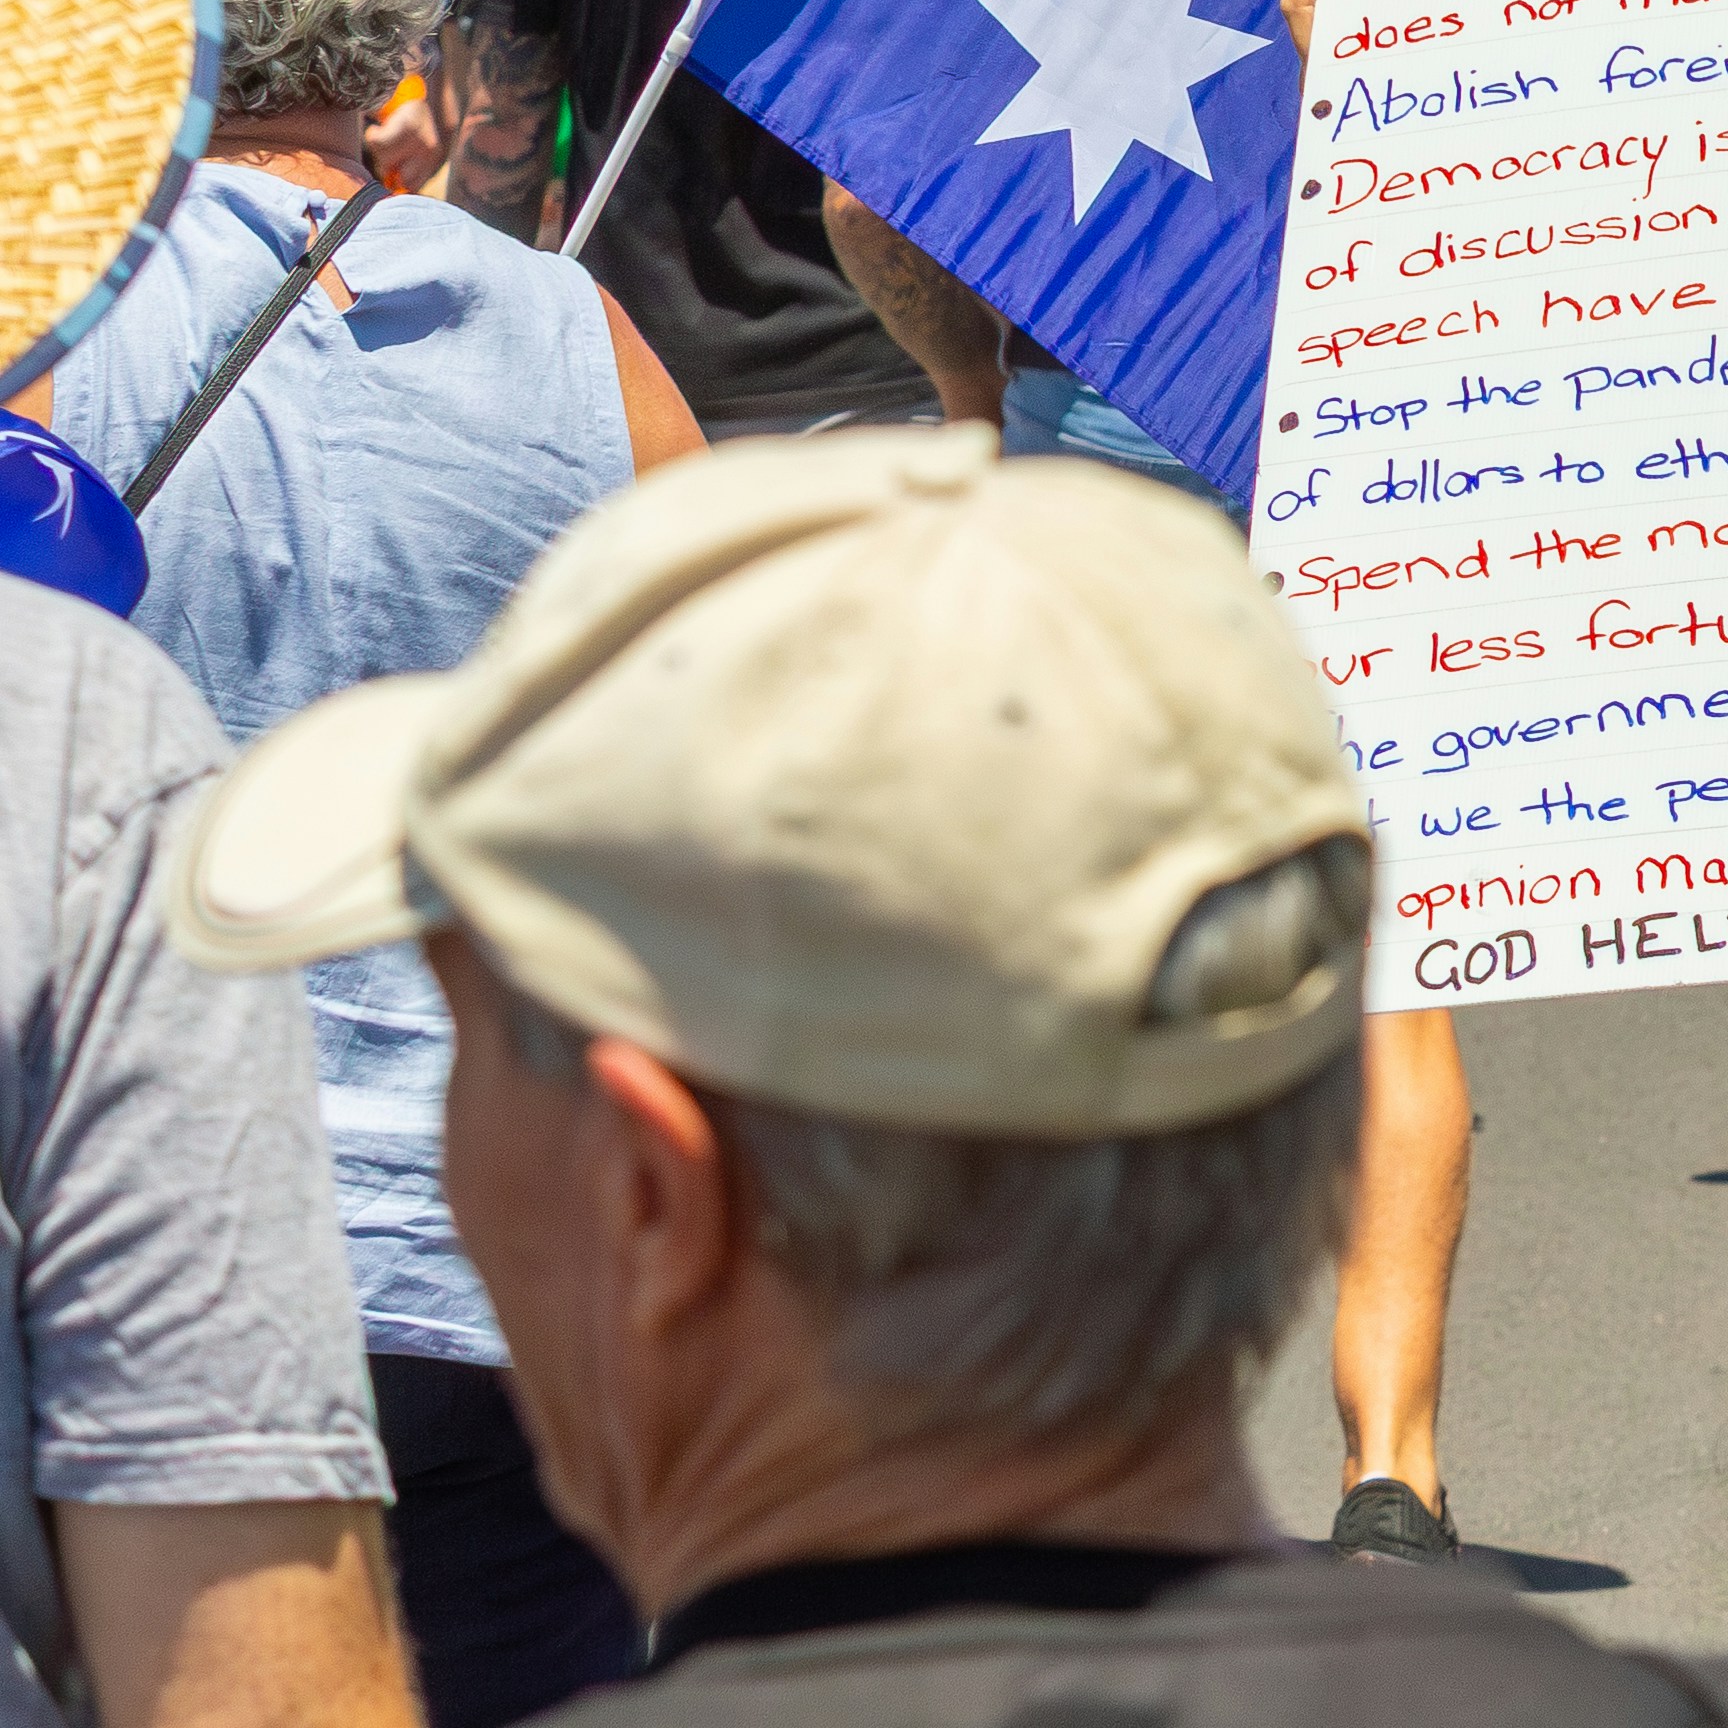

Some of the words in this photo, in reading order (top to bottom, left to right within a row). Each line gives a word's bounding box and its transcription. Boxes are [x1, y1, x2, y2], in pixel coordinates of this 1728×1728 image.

[1334, 13, 1464, 59] does
[1332, 71, 1557, 141] Abolish
[1328, 135, 1668, 214] Democracy
[1306, 240, 1372, 290] of
[1298, 300, 1499, 368] speech
[1542, 283, 1716, 327] have
[1314, 398, 1427, 438] Stop
[1447, 377, 1541, 412] the
[1268, 468, 1330, 521] of
[1363, 459, 1524, 503] dollars
[1540, 453, 1604, 483] to
[1289, 540, 1489, 611] Spend
[1510, 530, 1621, 569] the
[1303, 648, 1393, 686] ur
[1431, 630, 1545, 672] less
[1332, 714, 1403, 771] he
[1421, 806, 1498, 836] we
[1521, 782, 1628, 824] the
[1397, 868, 1600, 930] opinion
[1416, 930, 1536, 990] GOD
